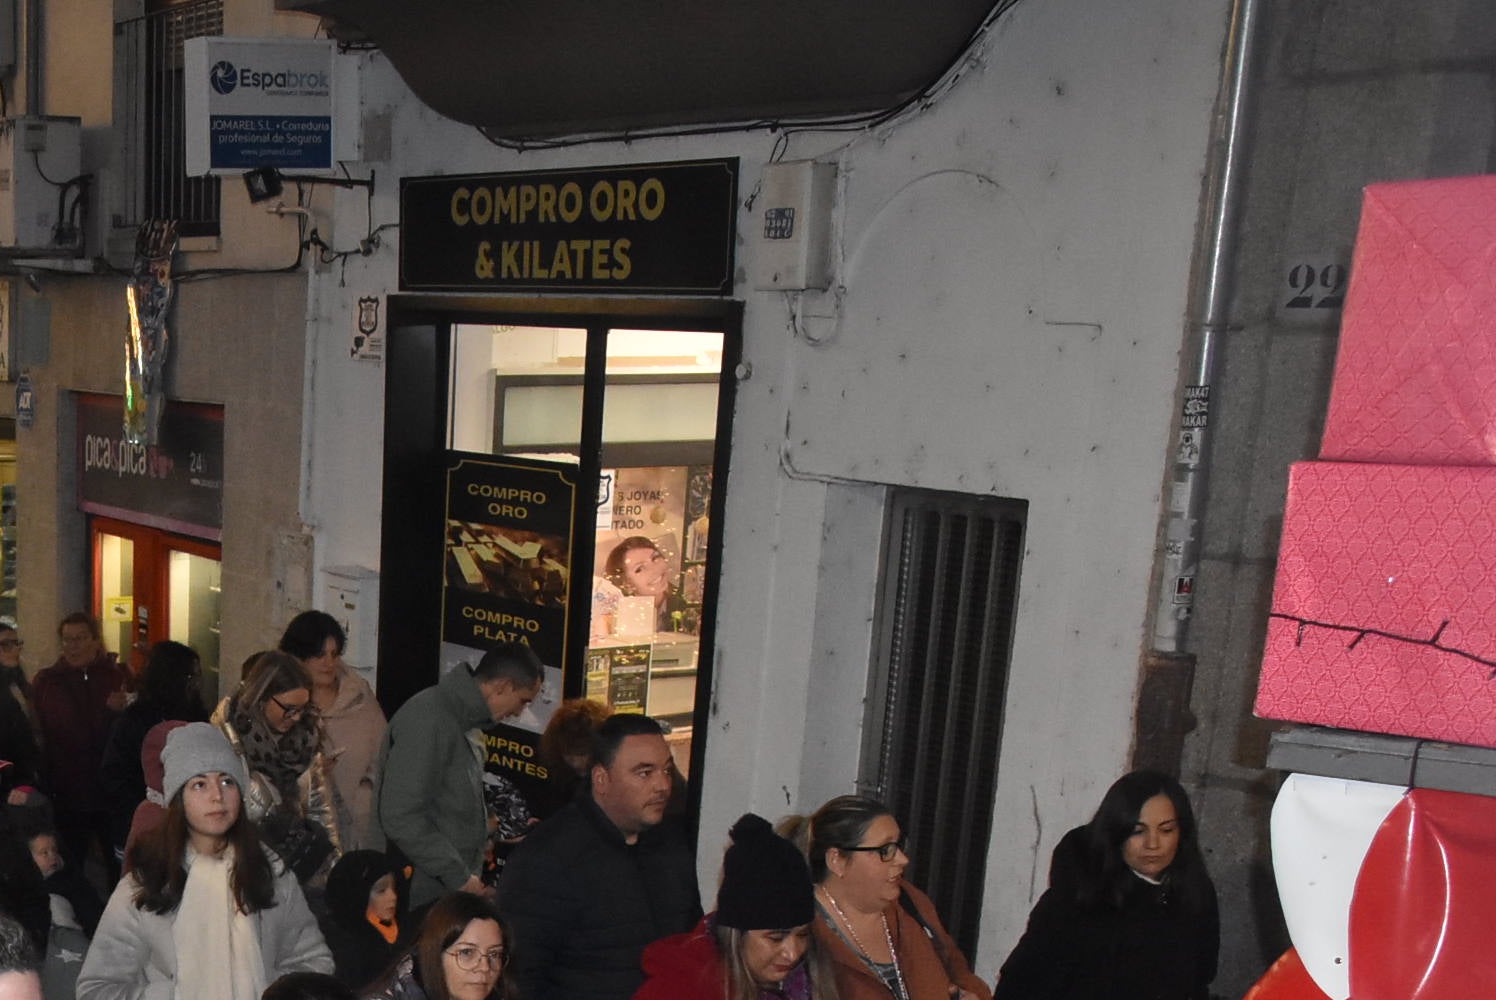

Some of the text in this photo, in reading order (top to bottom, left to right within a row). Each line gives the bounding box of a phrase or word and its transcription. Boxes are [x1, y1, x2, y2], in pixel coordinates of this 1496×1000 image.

[240, 69, 329, 90] Espabrok
[211, 120, 255, 132] JOMAREL
[218, 131, 323, 146] profesional de Seguros
[450, 177, 666, 226] COMPRO ORO
[474, 238, 633, 280] & KILATES
[1285, 263, 1345, 309] 22
[467, 482, 547, 505] COMPRO
[487, 502, 529, 520] ORO
[613, 520, 645, 530] TADO
[461, 605, 540, 633] COMPRO
[472, 625, 530, 647] PLATA
[483, 733, 535, 758] MPRO
[488, 752, 549, 780] ANTES
